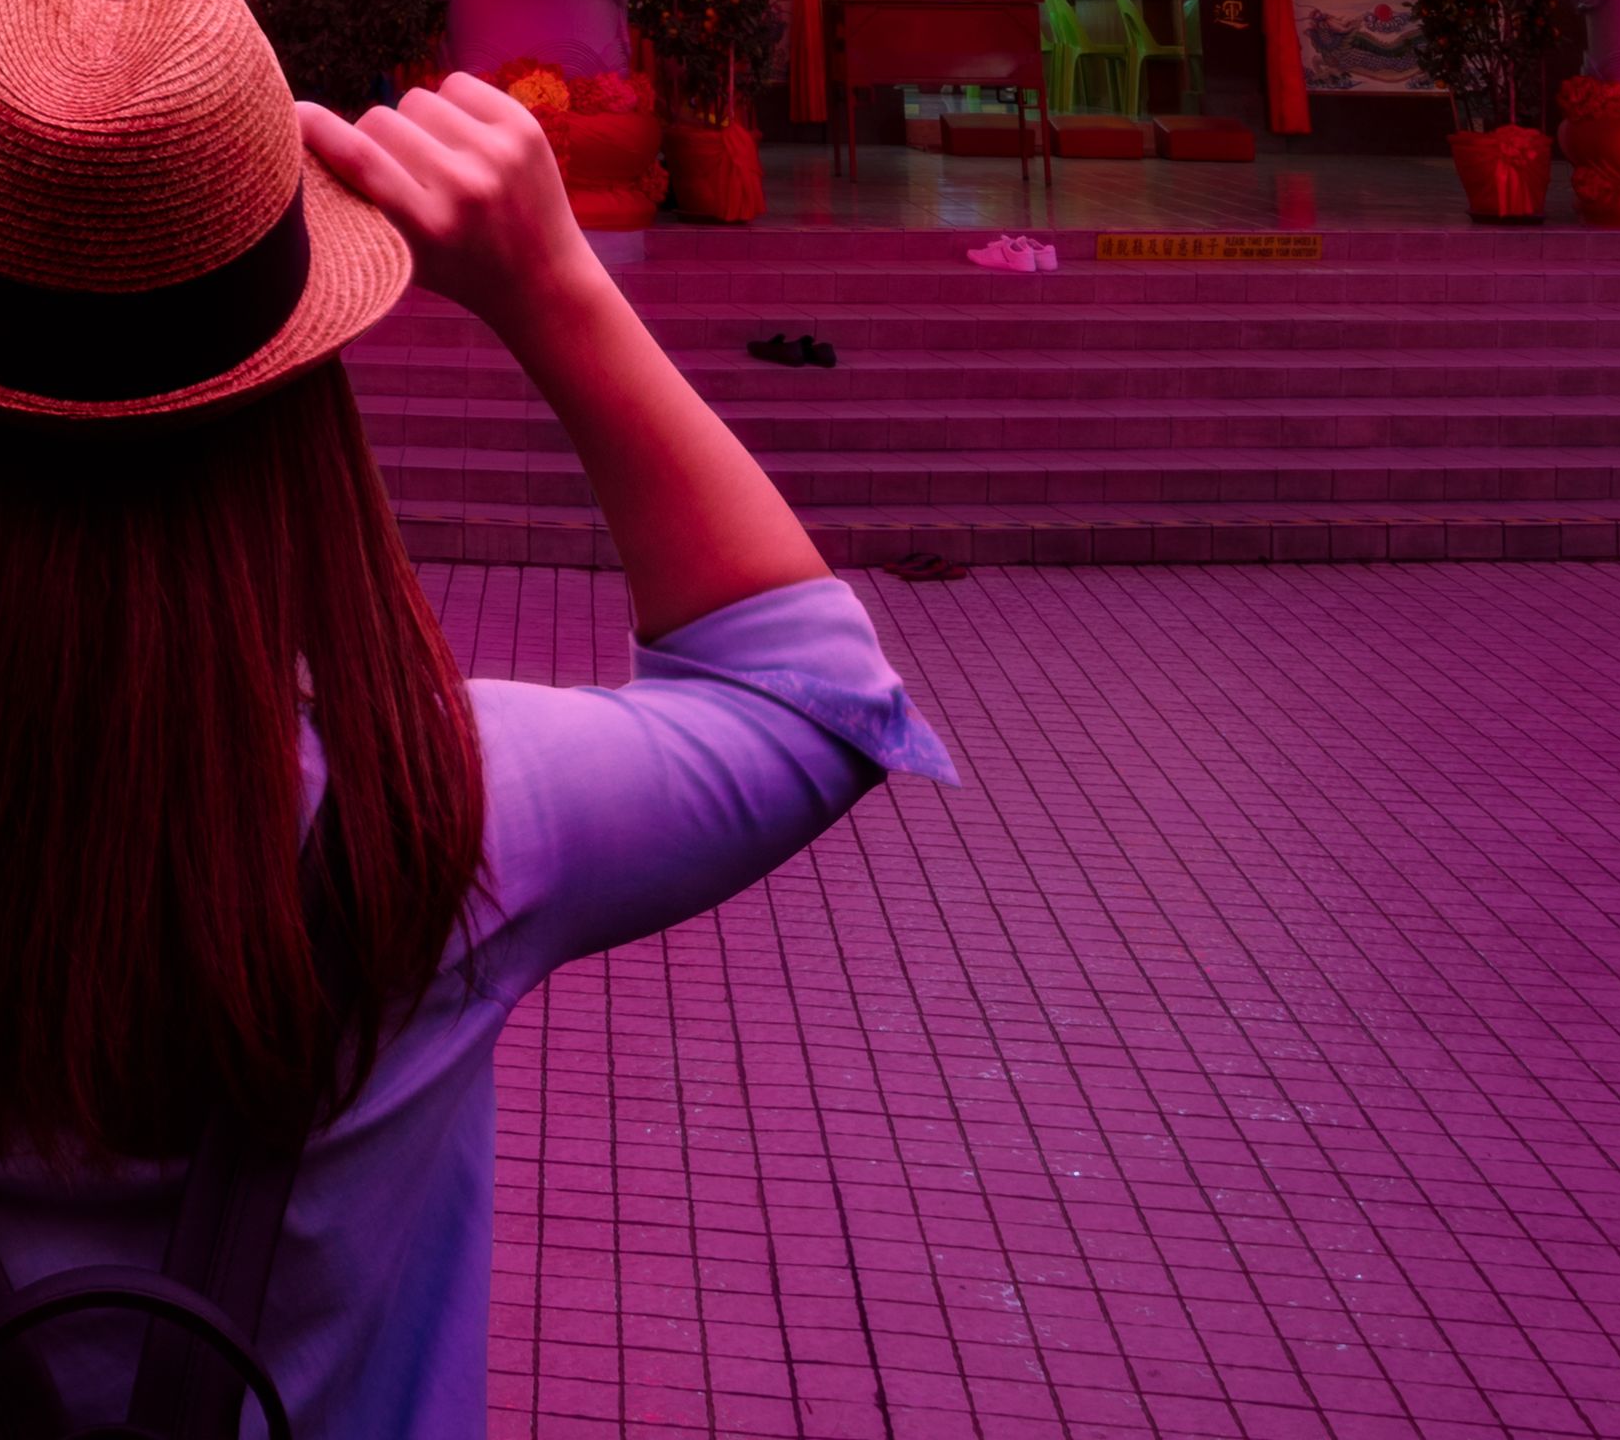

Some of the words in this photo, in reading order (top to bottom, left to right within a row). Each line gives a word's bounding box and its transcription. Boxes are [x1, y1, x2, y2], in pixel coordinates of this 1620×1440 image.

[1225, 236, 1245, 246] PLEASE
[1264, 237, 1274, 246] OFF
[1277, 237, 1291, 246] YOUR
